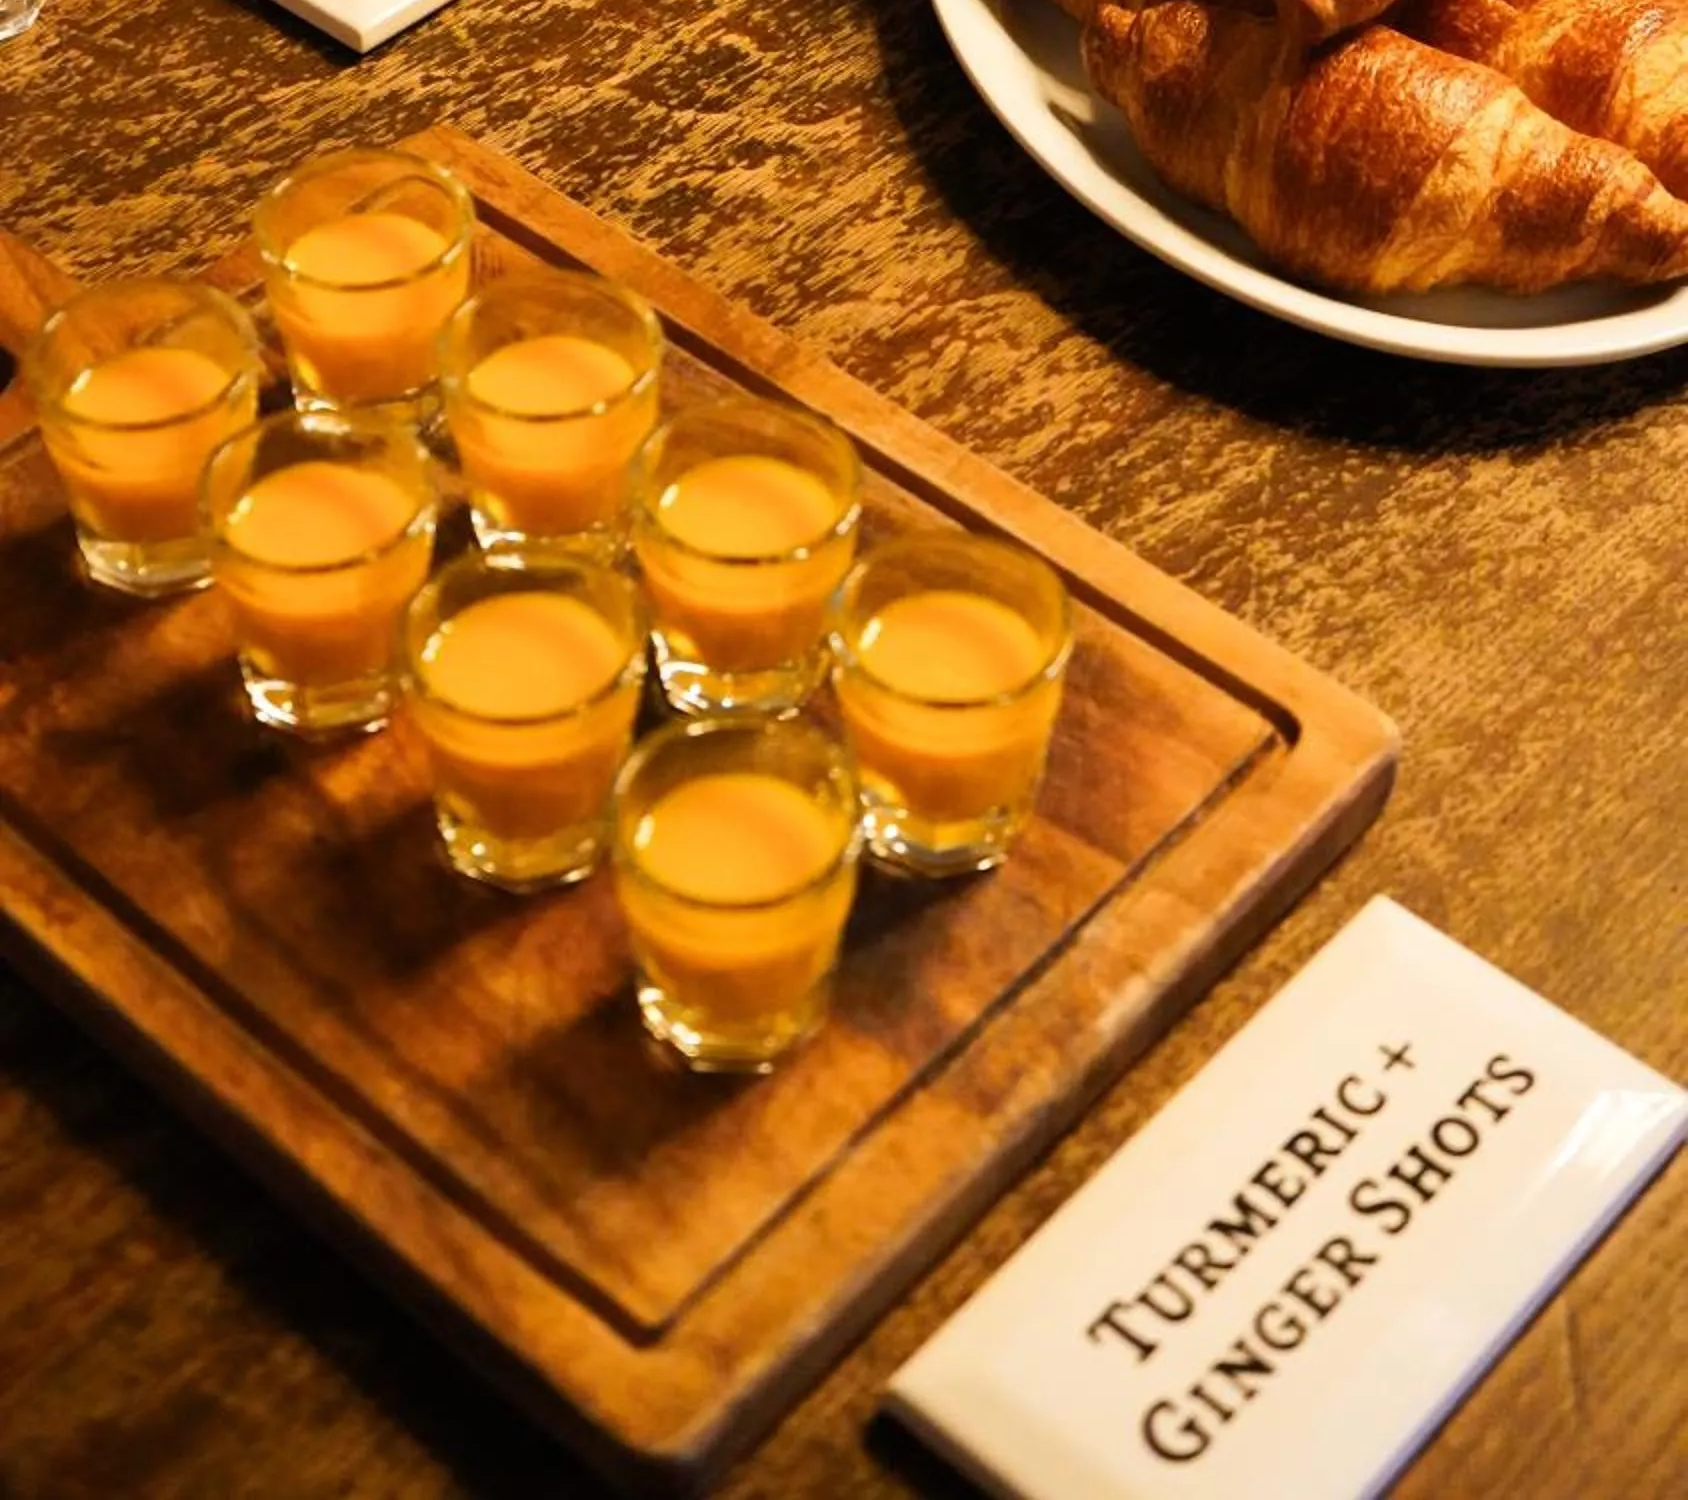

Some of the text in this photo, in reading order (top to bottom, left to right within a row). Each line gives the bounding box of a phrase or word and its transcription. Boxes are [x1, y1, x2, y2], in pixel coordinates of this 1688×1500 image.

[1086, 1074, 1386, 1363] TURMERIC
[1141, 1053, 1537, 1465] GINGER SHOTS
